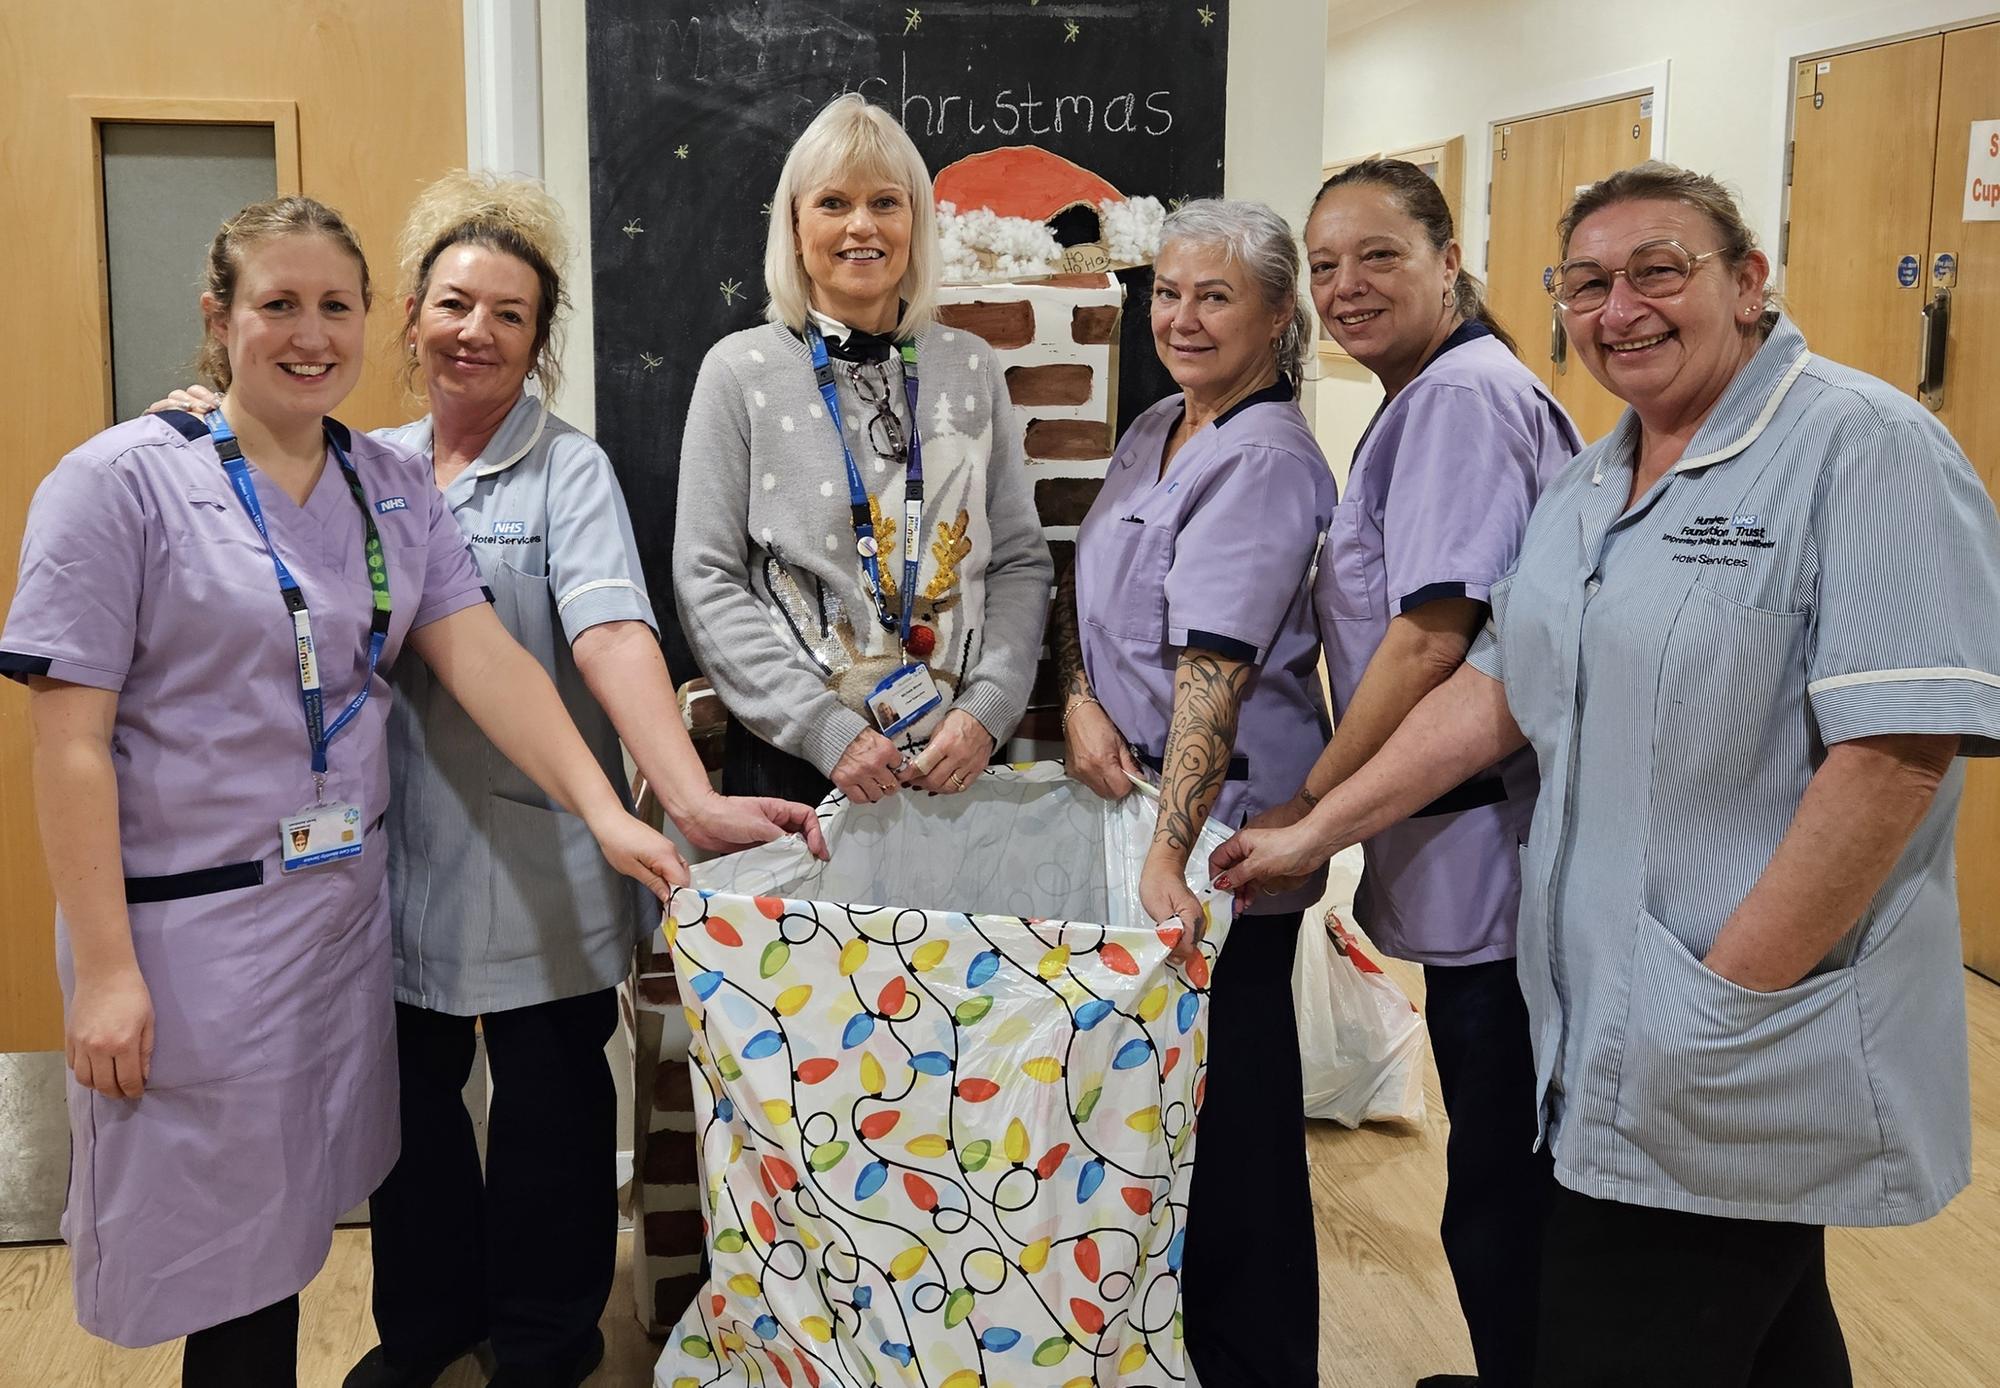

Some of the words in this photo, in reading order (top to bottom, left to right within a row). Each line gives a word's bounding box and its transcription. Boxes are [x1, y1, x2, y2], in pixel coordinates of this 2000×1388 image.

[1989, 133, 2000, 157] S
[381, 498, 406, 512] NHS
[1732, 515, 1758, 525] NHS
[494, 522, 524, 533] NHS
[1736, 526, 1766, 539] Trust
[471, 533, 496, 544] Hotel
[498, 535, 542, 545] Services
[1672, 553, 1698, 564] Hotel
[1698, 554, 1749, 568] Services
